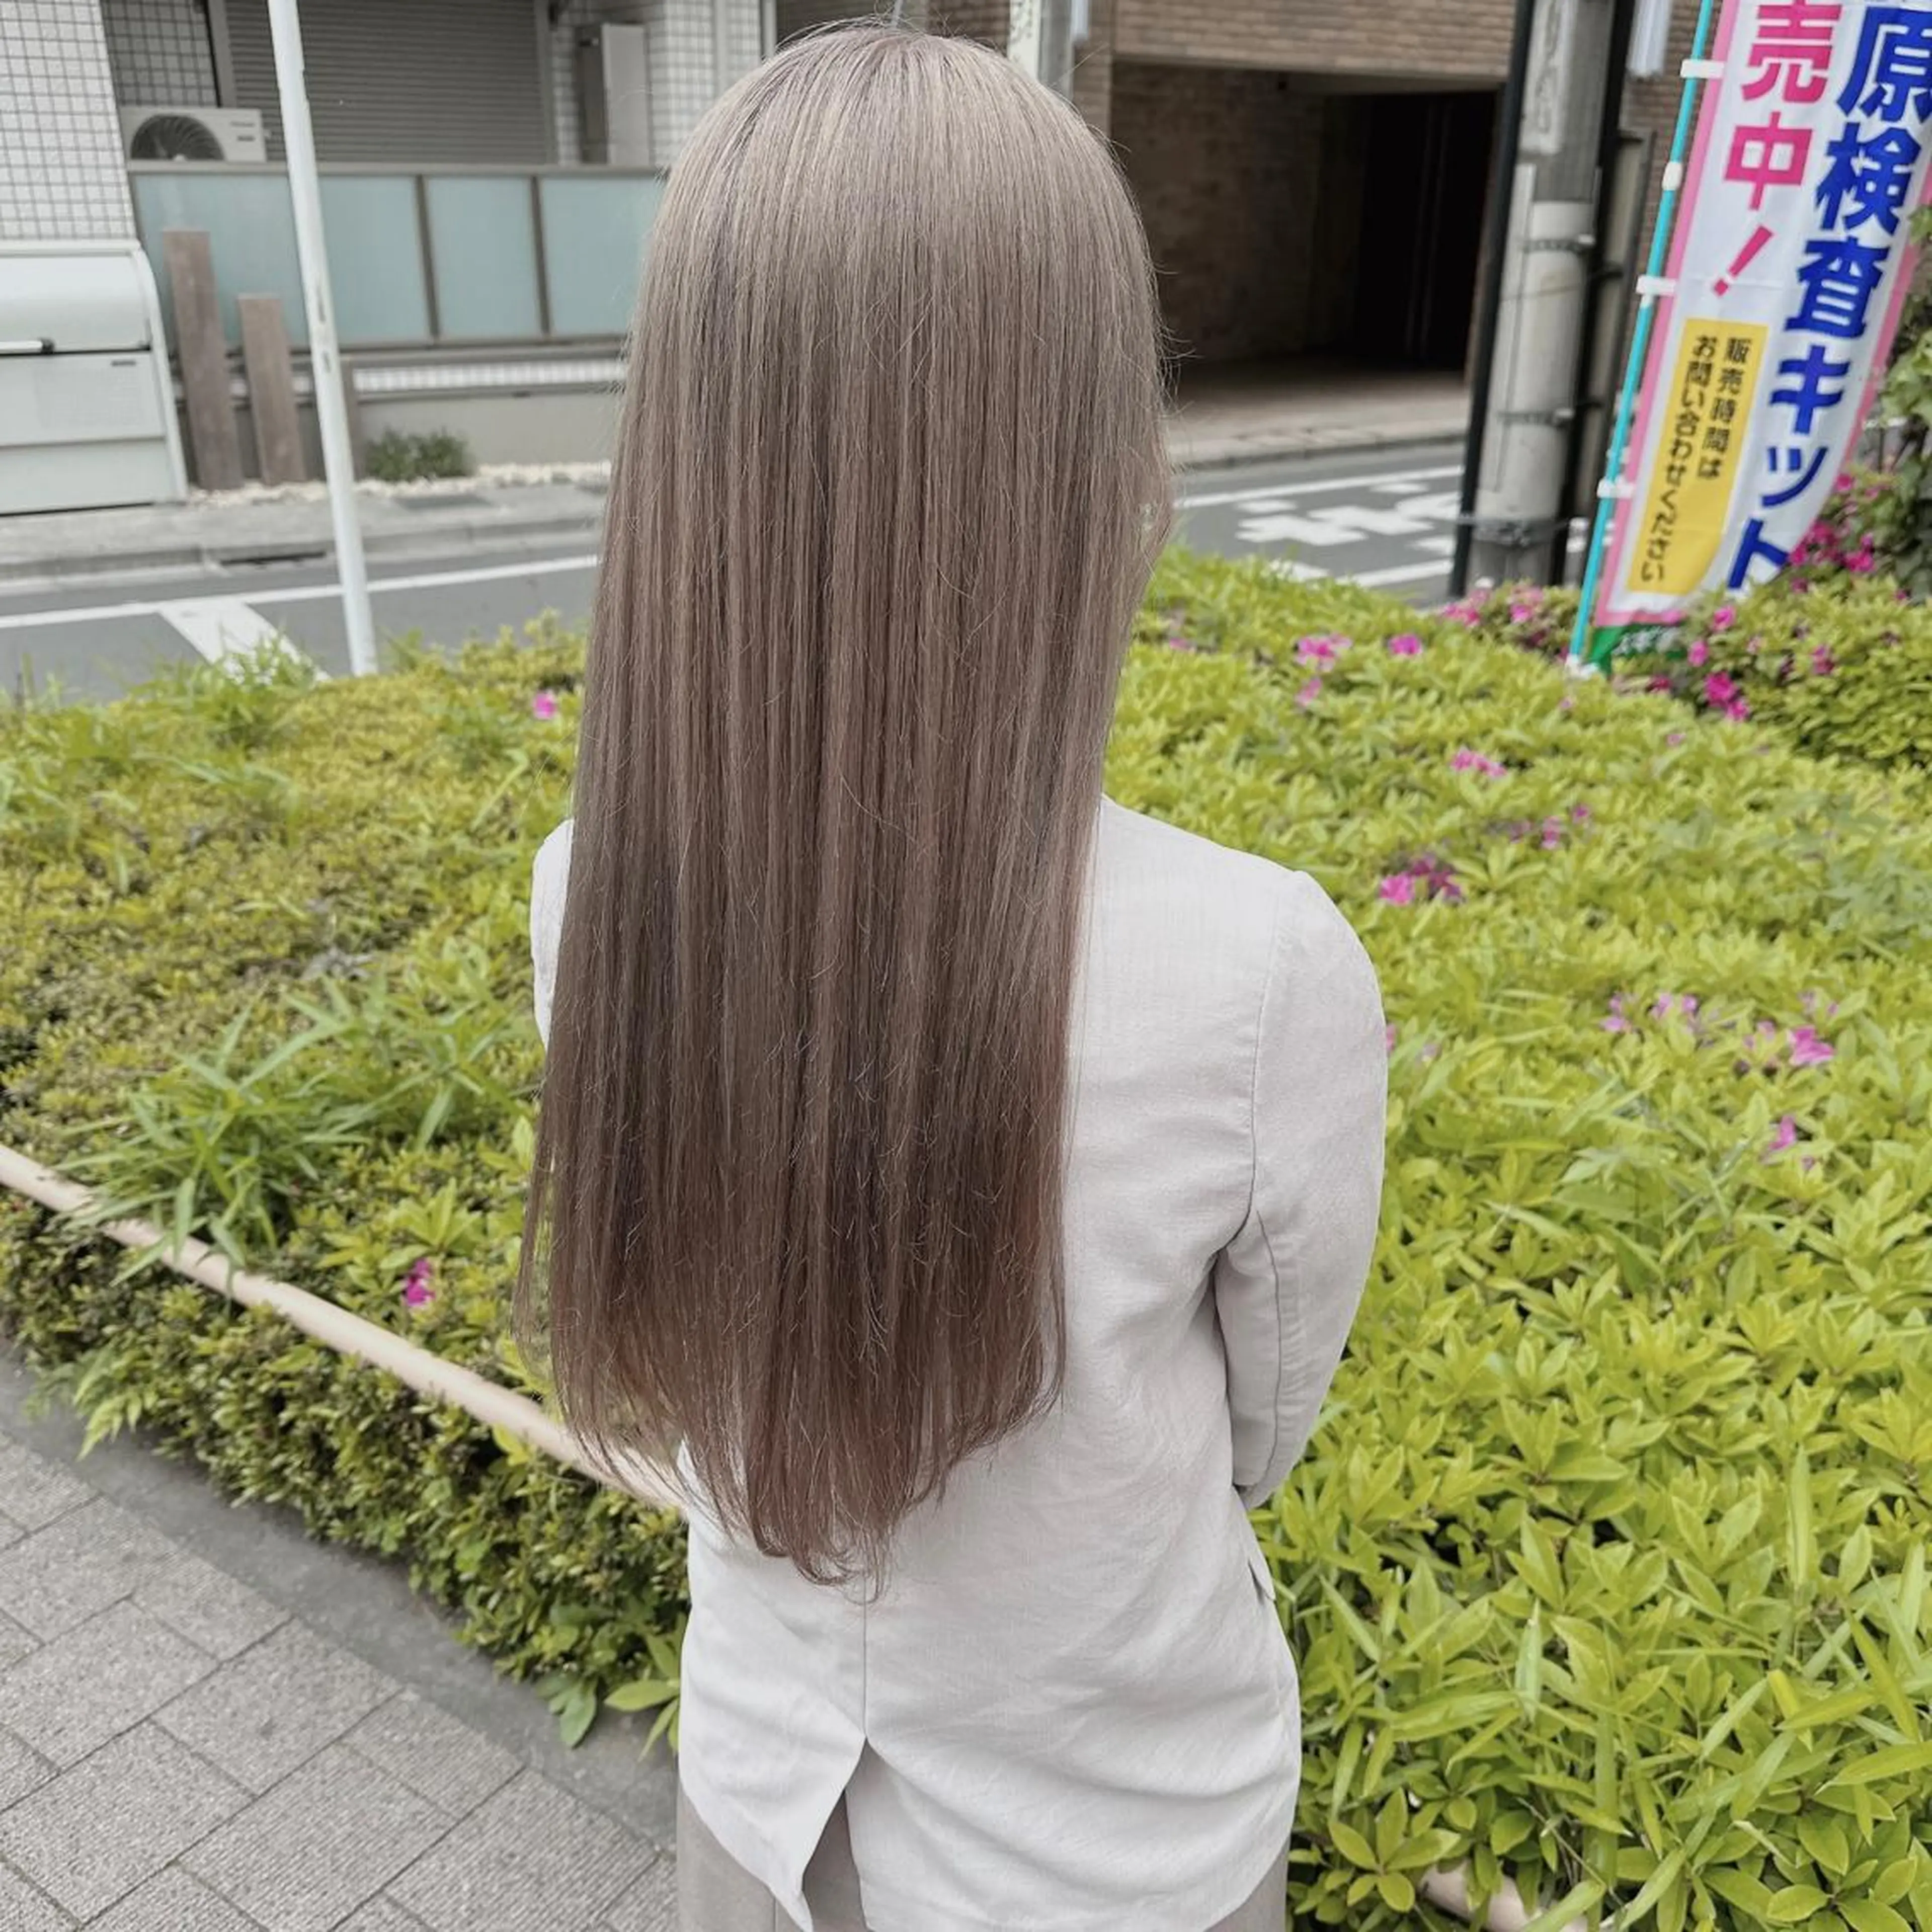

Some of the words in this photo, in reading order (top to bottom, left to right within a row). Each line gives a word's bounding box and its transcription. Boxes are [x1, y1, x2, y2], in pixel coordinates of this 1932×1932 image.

[1697, 337, 1752, 480] 販売時間は
[1727, 6, 1932, 589] 原検査キット
[1640, 335, 1718, 583] お問い合わせください
